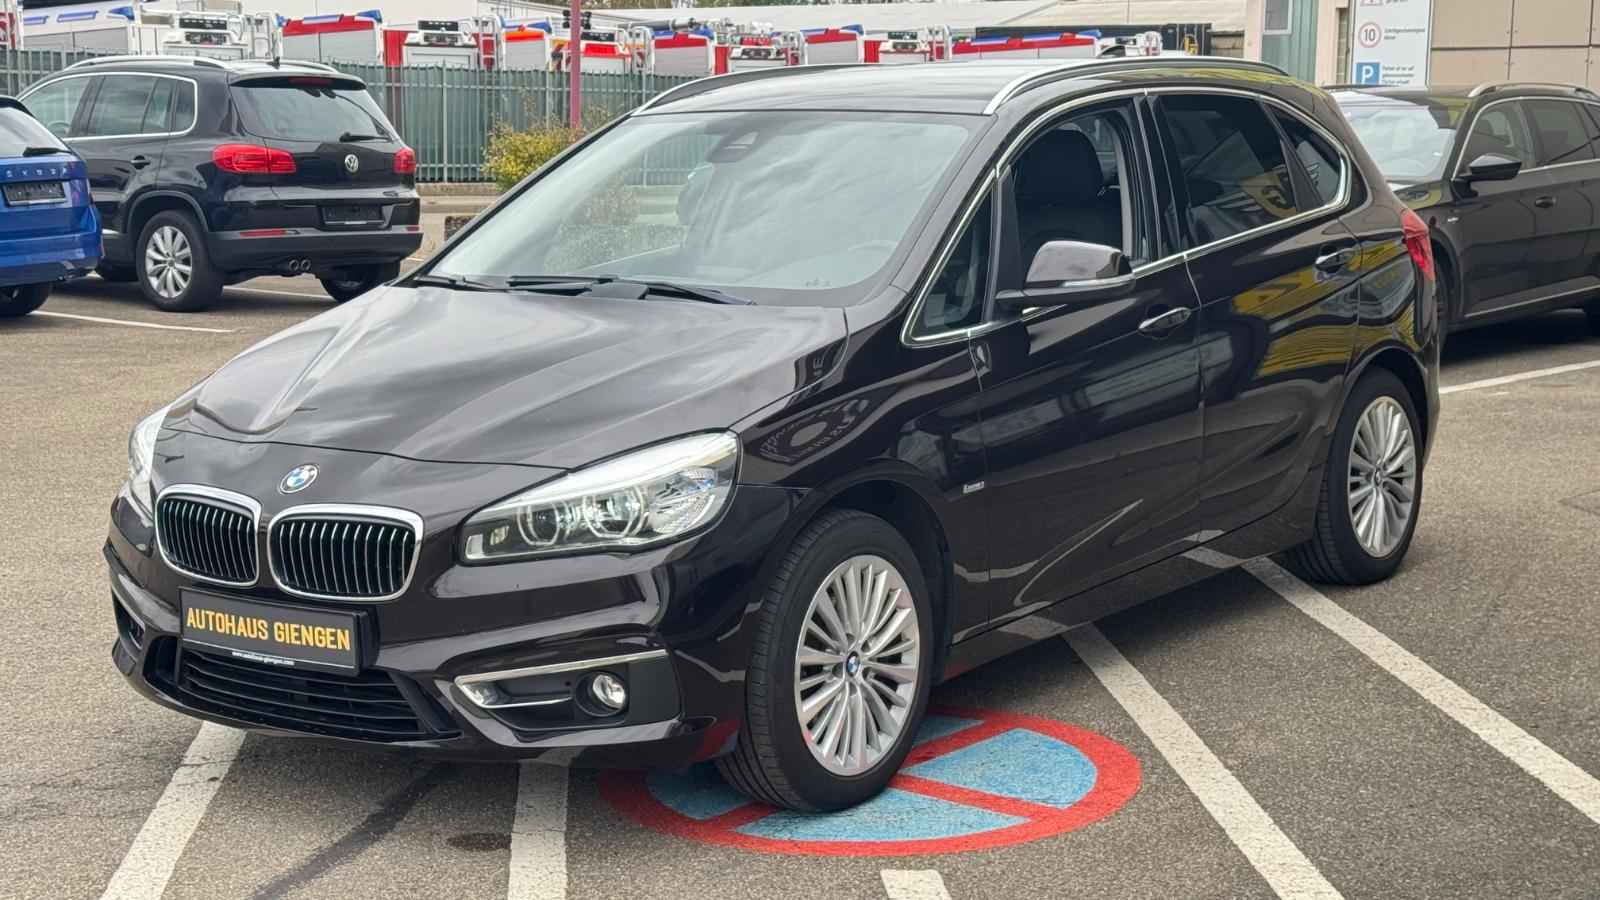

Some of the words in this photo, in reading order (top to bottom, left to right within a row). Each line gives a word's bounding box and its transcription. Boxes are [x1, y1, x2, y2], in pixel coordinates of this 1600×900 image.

[1364, 28, 1376, 42] 10
[1361, 65, 1374, 84] P
[186, 607, 269, 640] AUTOHAUS
[273, 621, 351, 651] GIENGEN
